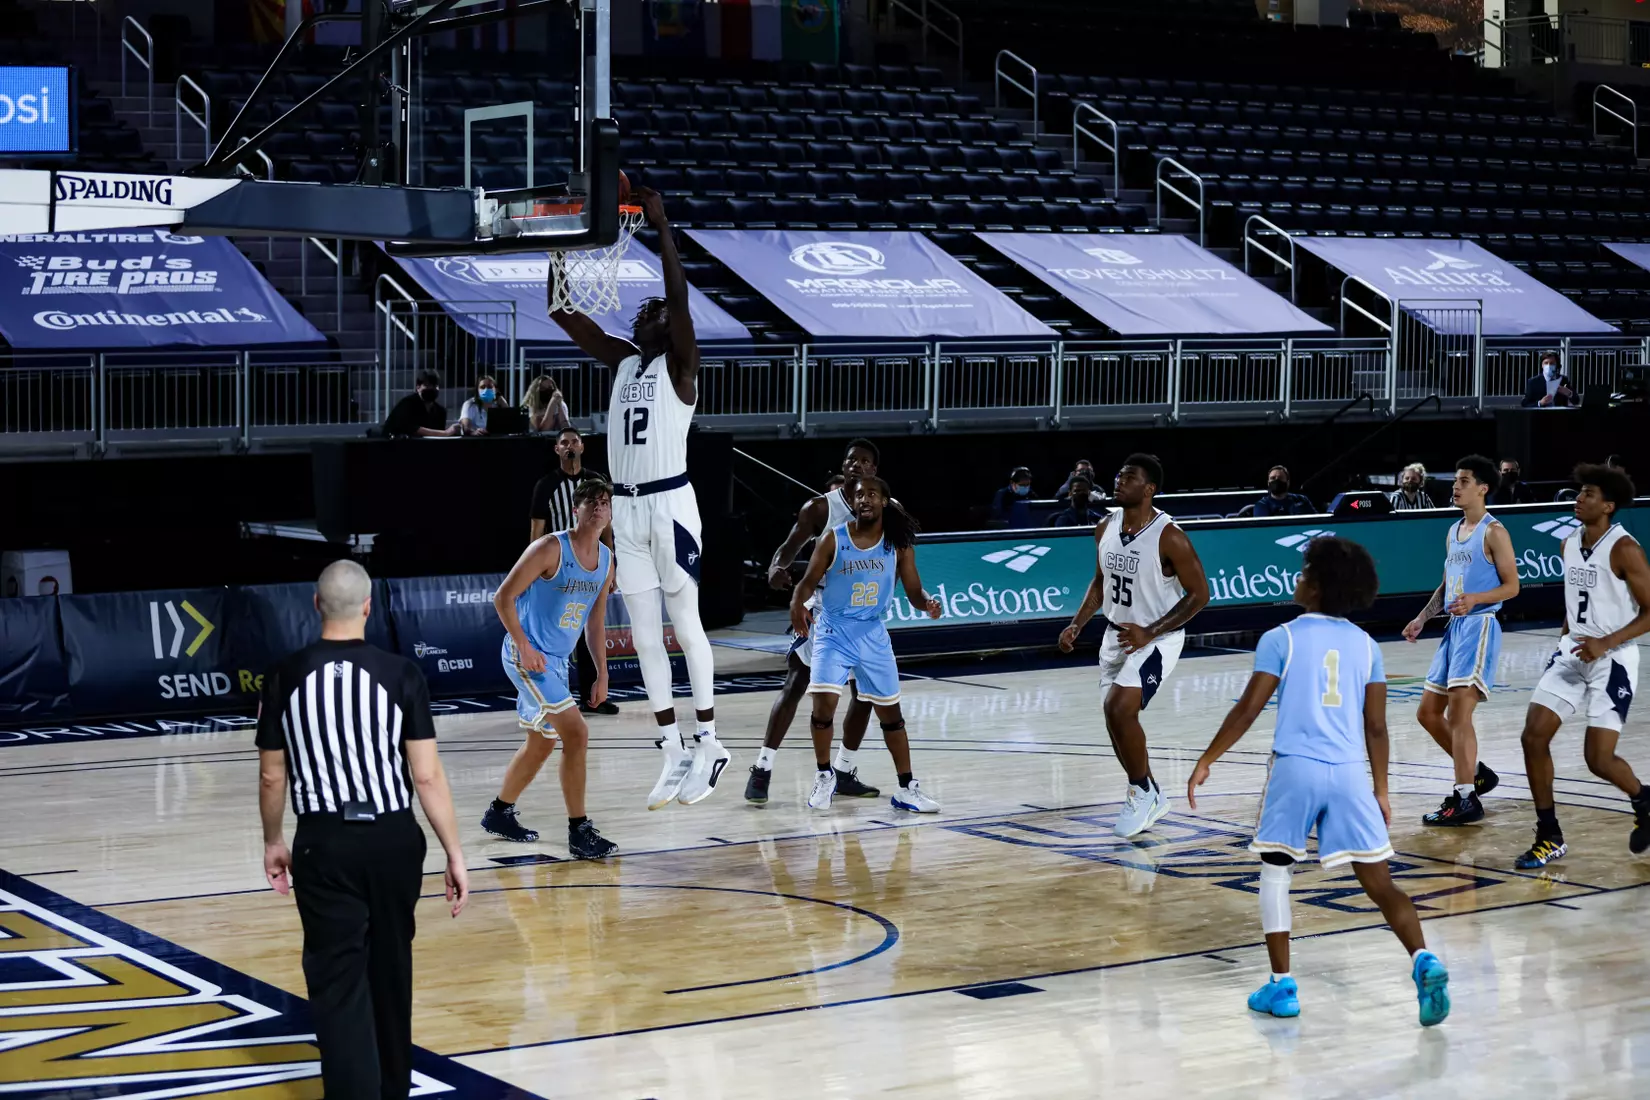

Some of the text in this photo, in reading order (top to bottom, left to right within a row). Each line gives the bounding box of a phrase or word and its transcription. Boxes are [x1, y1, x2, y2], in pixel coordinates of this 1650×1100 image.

[56, 174, 172, 206] SPALDING
[47, 254, 192, 270] Bud's
[30, 271, 111, 295] TIRE
[785, 278, 962, 290] MAGNOLIA
[1384, 266, 1511, 286] Altura
[33, 310, 239, 330] Continental
[623, 407, 649, 446] 12
[838, 557, 884, 576] HAWKS
[1105, 551, 1140, 574] CBU
[1110, 572, 1134, 607] 35
[1569, 566, 1598, 589] CBU
[851, 581, 879, 607] 22
[559, 602, 587, 630] 25
[1577, 590, 1589, 624] 2
[448, 659, 474, 670] CBU
[158, 672, 232, 699] SEND
[1321, 648, 1343, 708] 1
